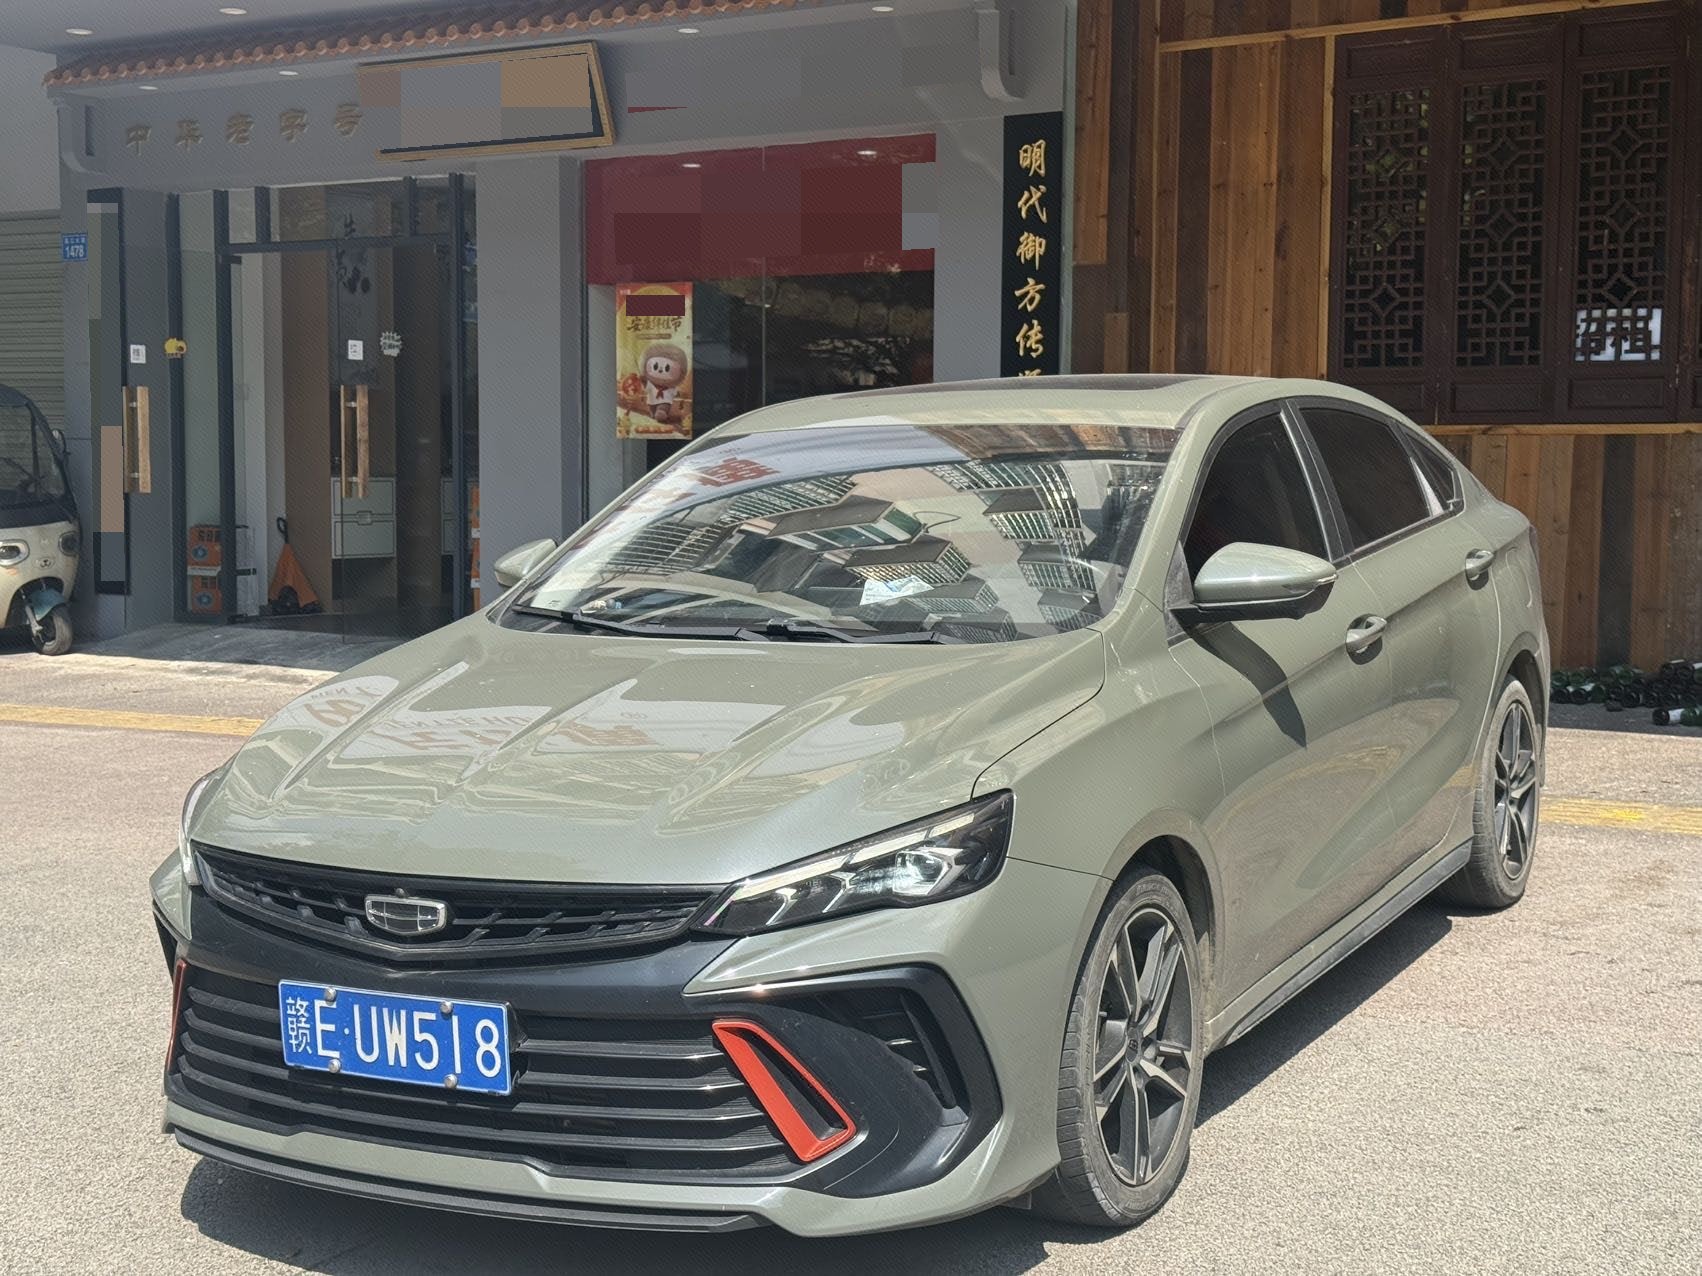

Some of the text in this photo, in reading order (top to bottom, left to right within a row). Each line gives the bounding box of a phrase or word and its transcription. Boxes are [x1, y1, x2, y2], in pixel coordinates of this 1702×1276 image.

[125, 103, 363, 157] 中华老字号
[65, 244, 84, 258] 1478
[1013, 138, 1048, 377] 明代御方传
